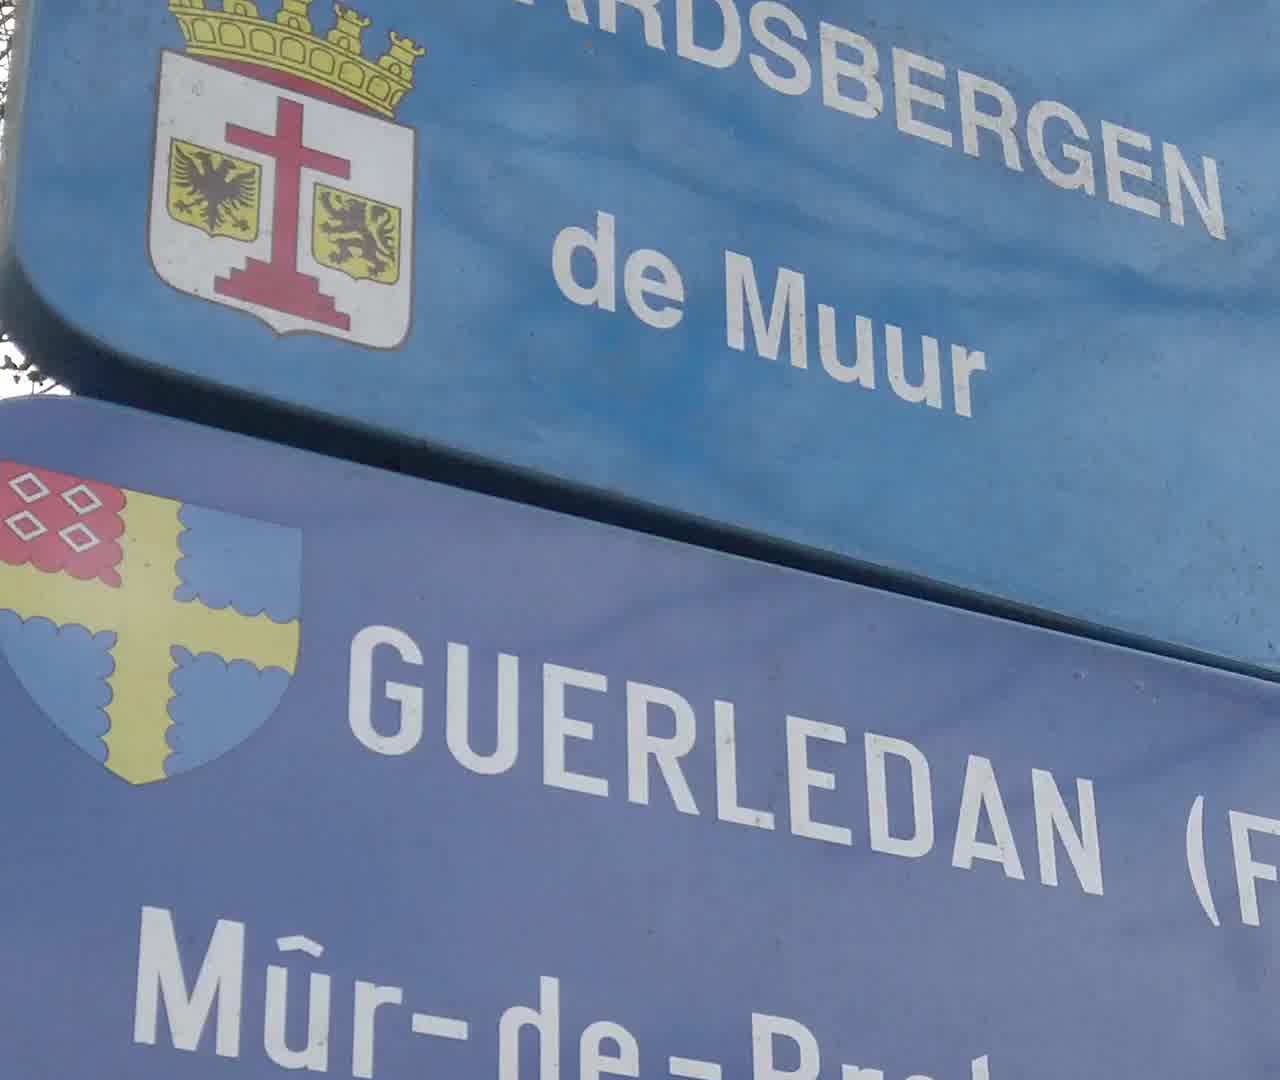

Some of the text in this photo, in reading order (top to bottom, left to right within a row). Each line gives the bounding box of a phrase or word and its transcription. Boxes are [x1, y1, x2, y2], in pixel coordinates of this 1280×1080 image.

[515, 0, 1228, 240] DSBERGEN
[552, 210, 987, 417] de Muur
[347, 624, 1106, 898] GUERLEDAN
